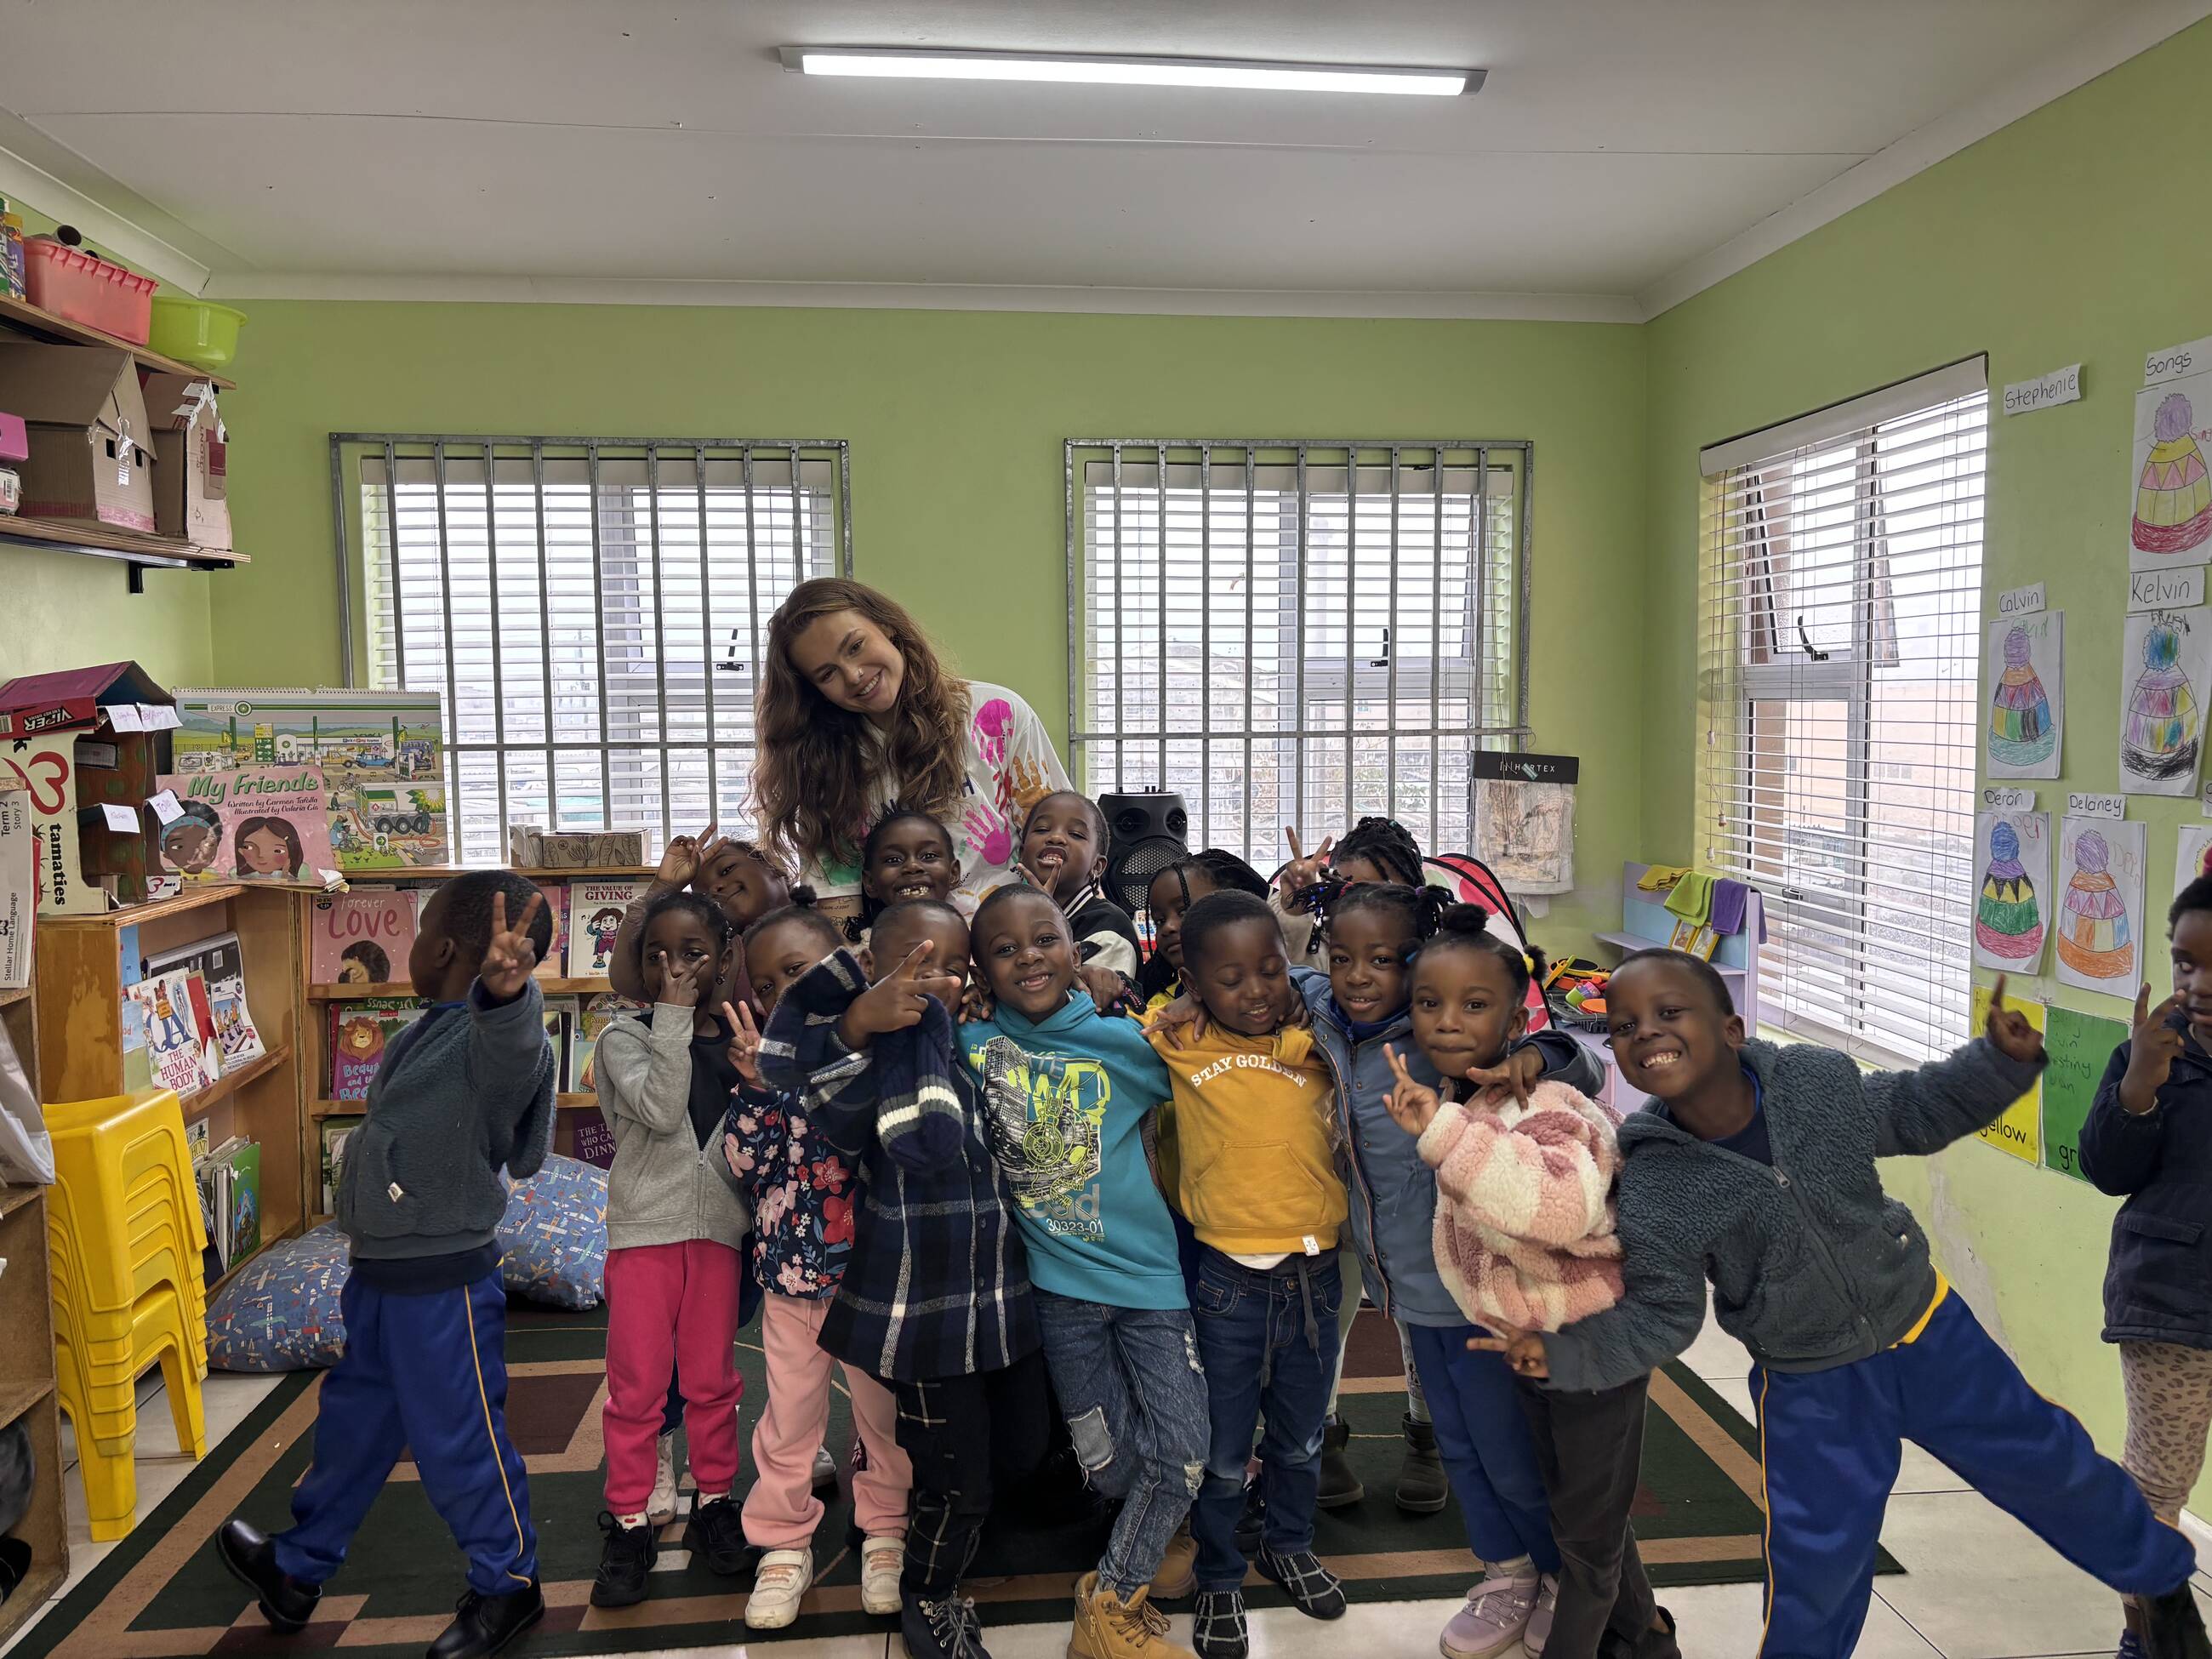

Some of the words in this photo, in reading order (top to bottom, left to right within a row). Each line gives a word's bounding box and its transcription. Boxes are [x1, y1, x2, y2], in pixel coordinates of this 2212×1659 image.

[2146, 351, 2192, 377] Songs
[2131, 573, 2191, 603] Kelvin
[186, 775, 226, 805] My
[232, 772, 319, 795] Friends
[1984, 790, 2023, 806] Deron
[255, 800, 265, 808] by
[271, 807, 280, 815] by
[2069, 795, 2122, 817] Delaney
[1, 810, 10, 836] Term
[14, 808, 22, 830] Story
[49, 823, 68, 905] tamaties
[584, 891, 634, 901] GIVING
[4, 956, 13, 981] Stellar
[9, 892, 18, 929] Language
[367, 997, 396, 1010] Seuss
[168, 1048, 185, 1063] THE
[160, 1054, 197, 1081] HUMAN
[1190, 1055, 1234, 1088] STAY
[1235, 1053, 1308, 1088] GOLDEN
[170, 1069, 196, 1091] BODY
[339, 1086, 369, 1102] Bea
[578, 1126, 597, 1137] THE
[581, 1136, 598, 1147] WHO
[600, 1132, 612, 1143] CA
[584, 1142, 617, 1160] DINN
[1046, 1217, 1103, 1234] 30323-01
